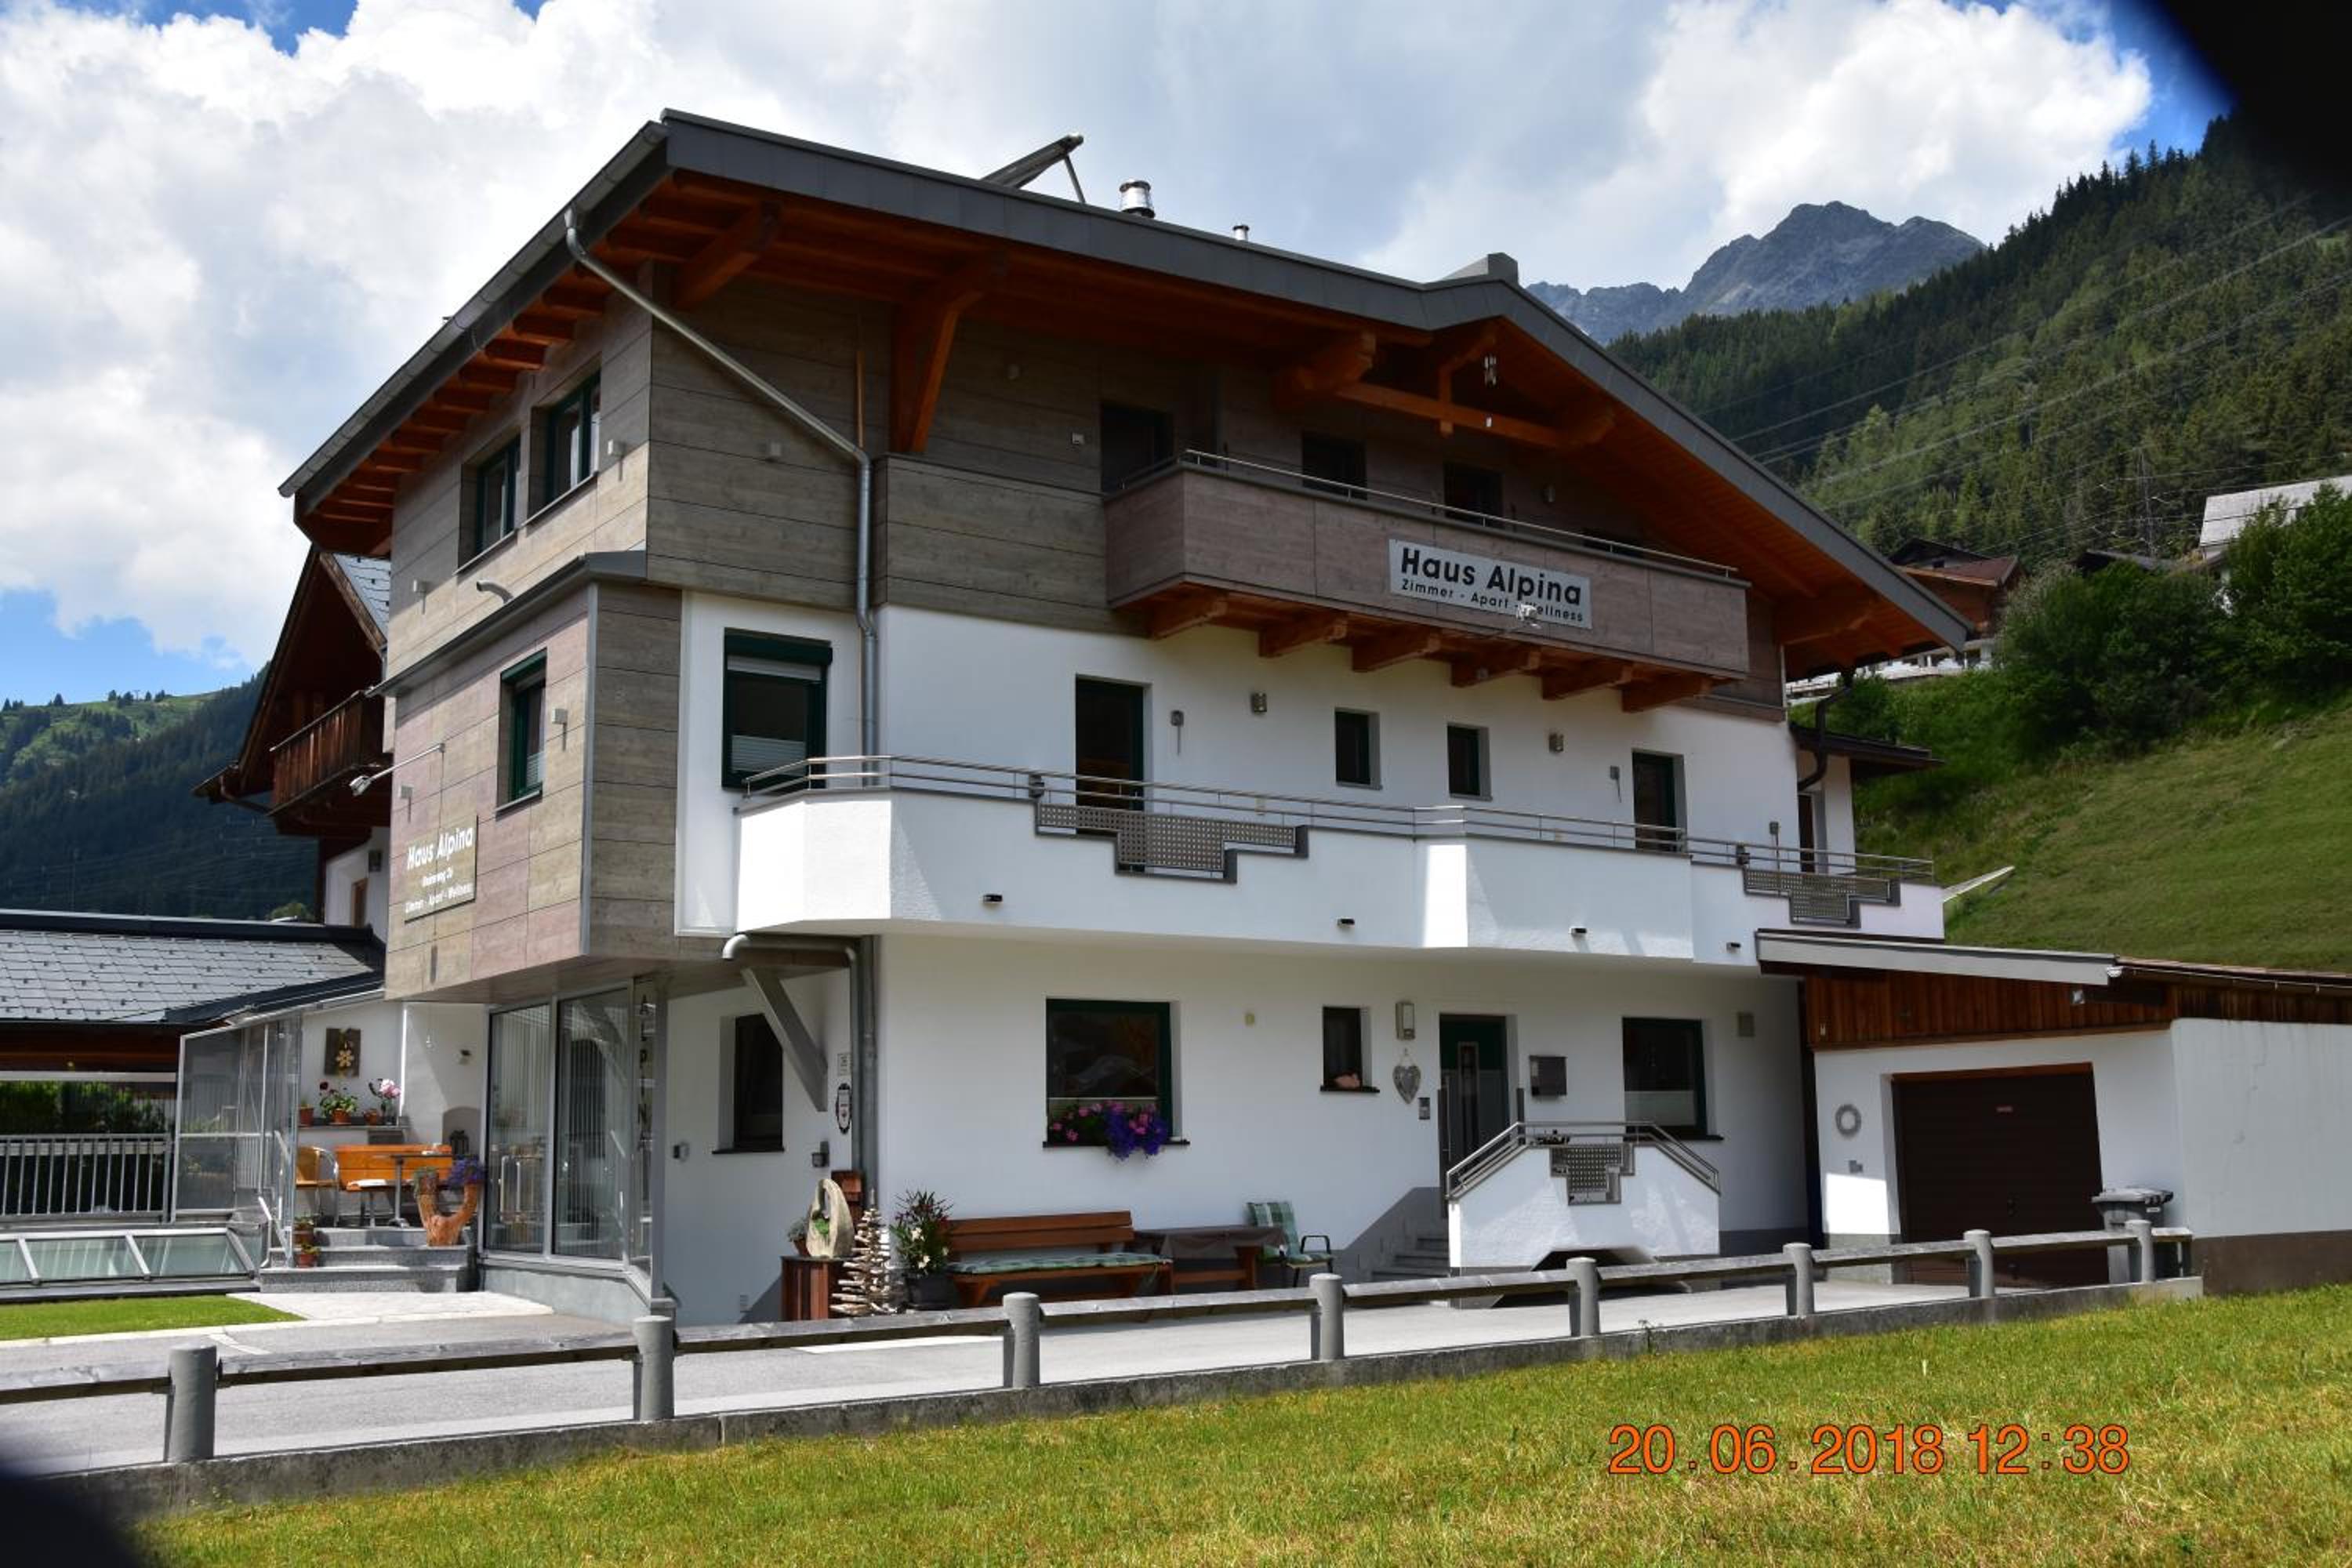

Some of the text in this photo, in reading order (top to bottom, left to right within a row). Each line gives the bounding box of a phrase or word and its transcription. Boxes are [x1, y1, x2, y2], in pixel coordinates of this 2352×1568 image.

[1400, 546, 1581, 606] Haus Alpina
[1401, 578, 1454, 599] Zimmer
[1470, 592, 1509, 609] Apart
[407, 826, 474, 871] Haus Alpina
